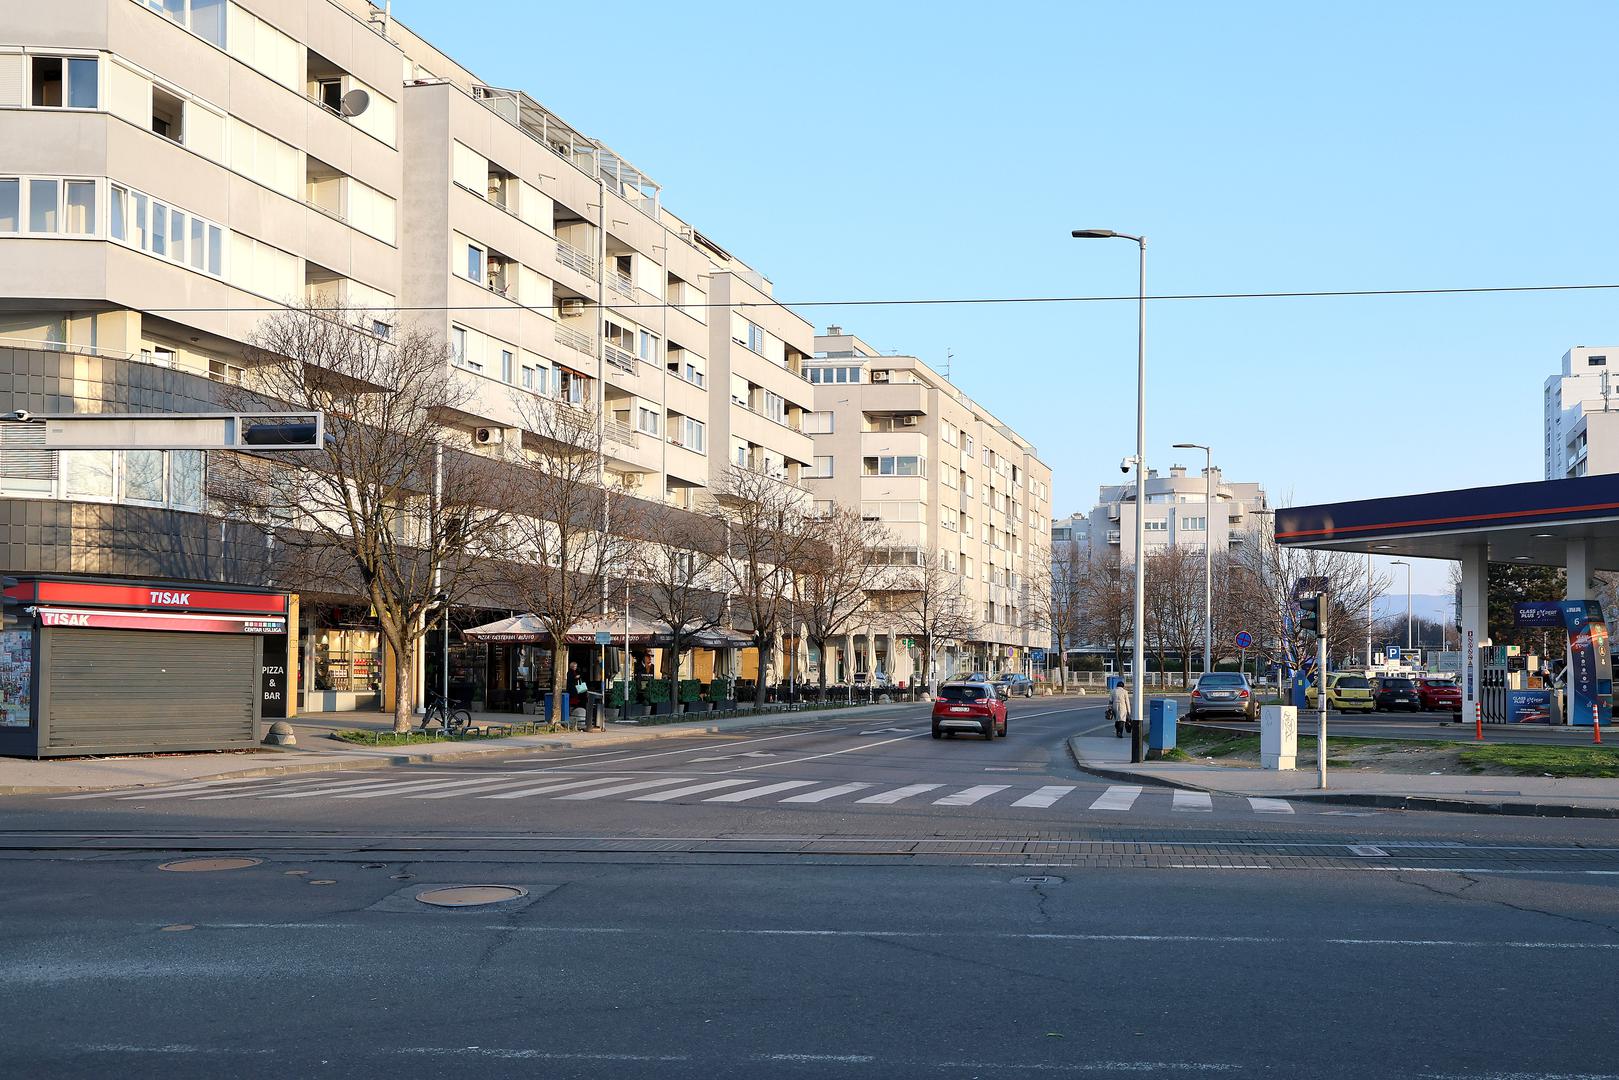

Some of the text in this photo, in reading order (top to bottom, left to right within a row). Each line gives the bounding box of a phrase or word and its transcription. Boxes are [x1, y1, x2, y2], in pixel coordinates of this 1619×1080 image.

[150, 591, 190, 605] TISAK
[45, 613, 91, 626] TISAK
[1574, 617, 1580, 625] 6
[1389, 648, 1397, 657] P
[262, 666, 284, 674] PIZZA
[269, 678, 276, 687] &
[264, 692, 281, 700] BAR
